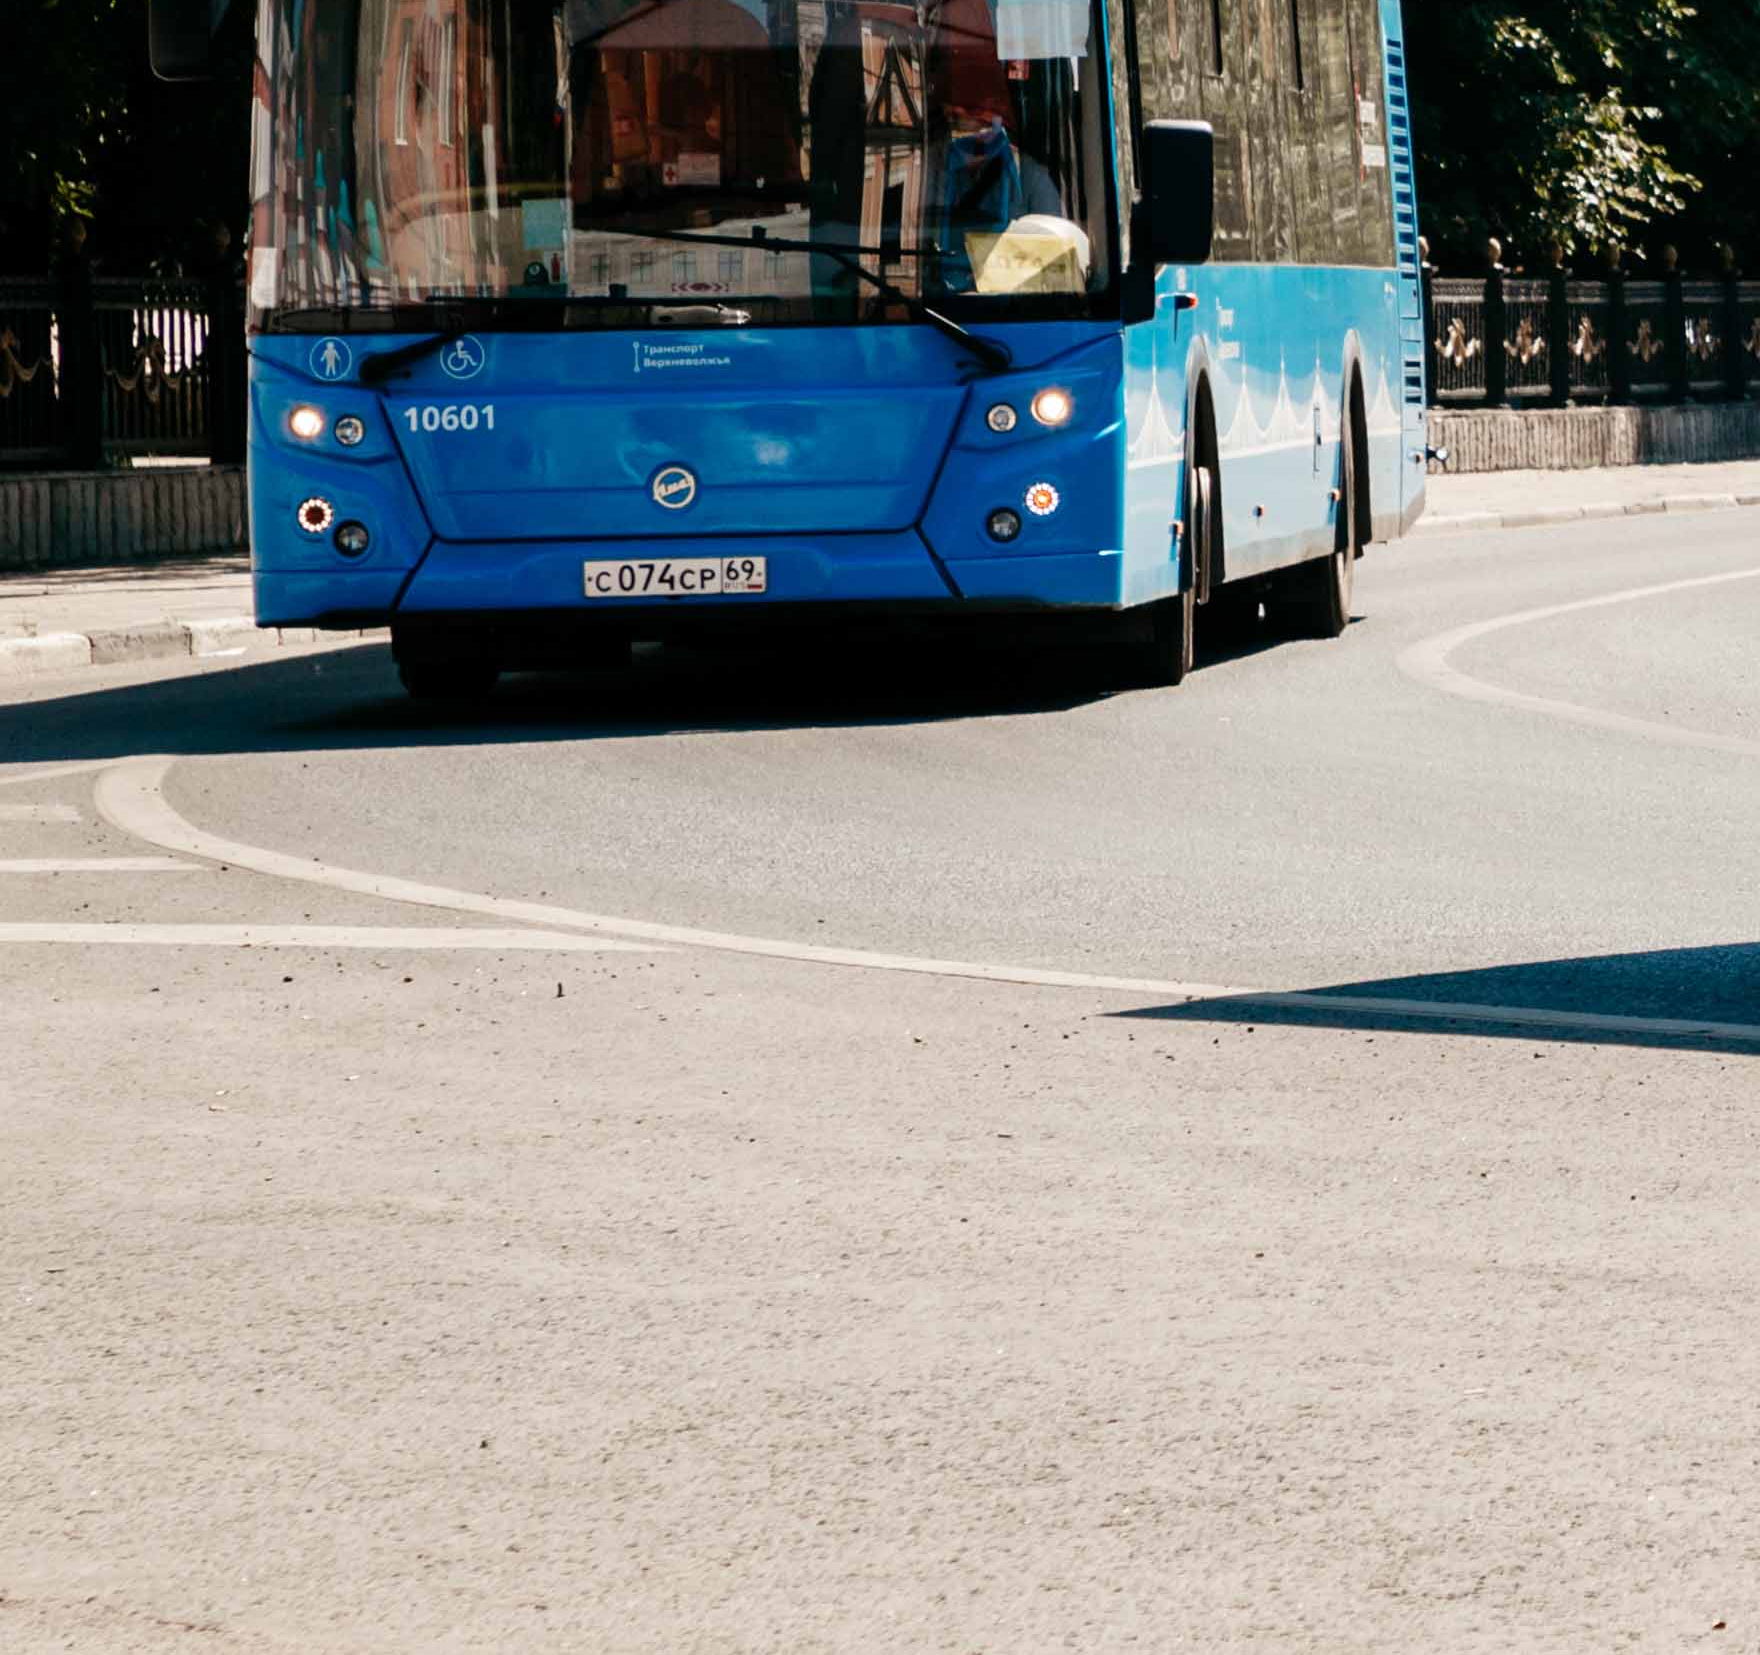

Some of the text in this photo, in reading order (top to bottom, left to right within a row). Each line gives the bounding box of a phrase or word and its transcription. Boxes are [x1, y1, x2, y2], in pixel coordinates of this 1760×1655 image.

[643, 344, 704, 356] Транспорт
[643, 356, 731, 369] Верхневолжья
[404, 404, 494, 432] 10601
[725, 559, 755, 582] 69
